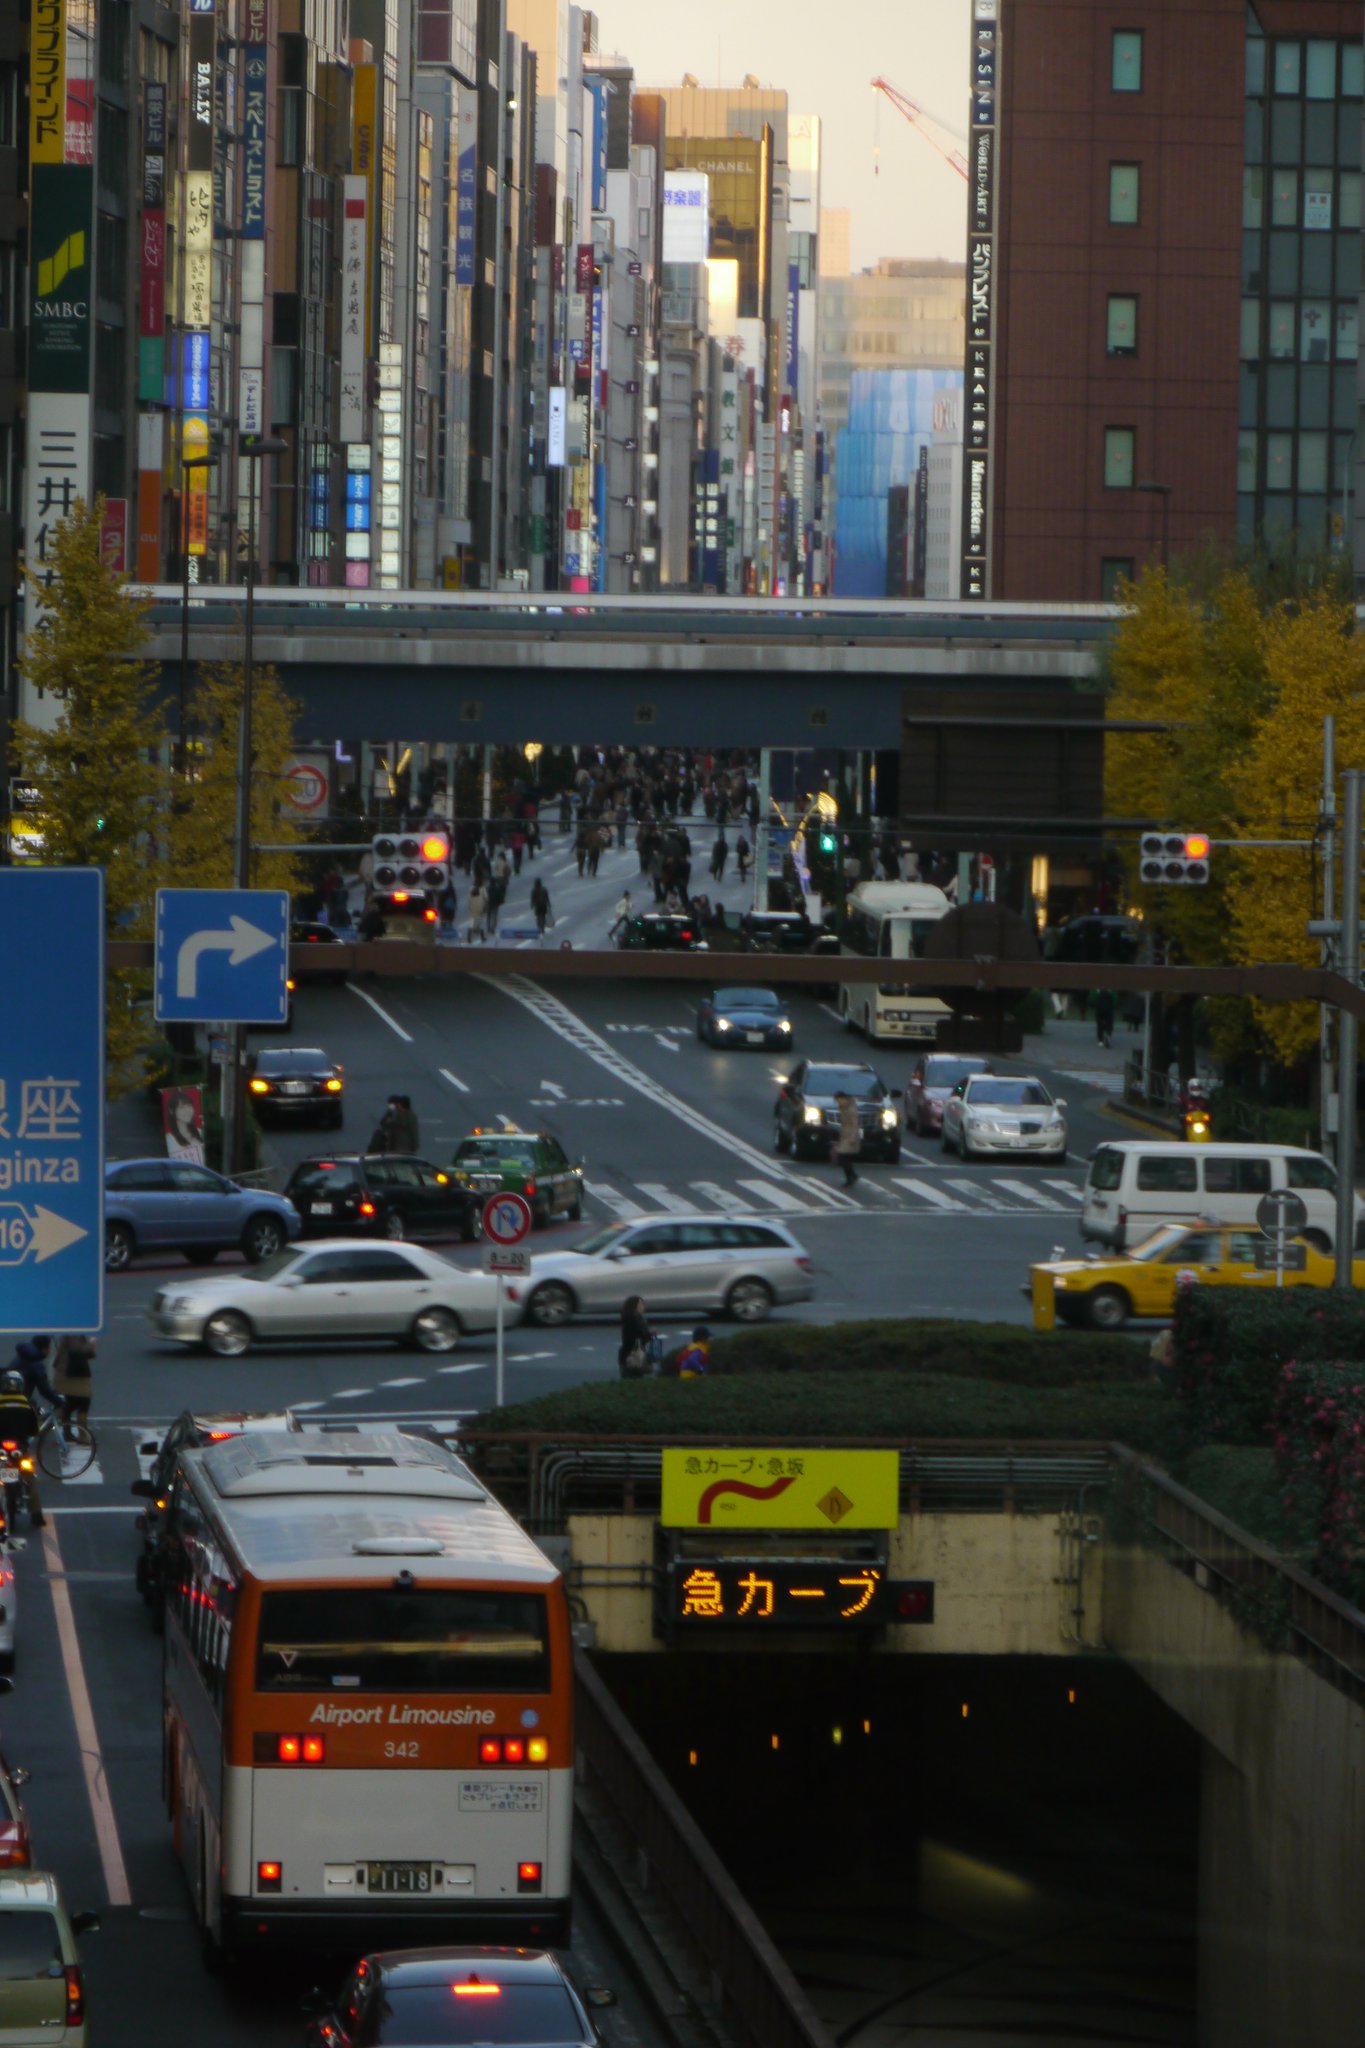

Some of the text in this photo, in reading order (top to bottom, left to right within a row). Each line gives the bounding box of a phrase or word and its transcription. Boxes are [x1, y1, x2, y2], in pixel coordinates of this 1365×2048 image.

[36, 0, 61, 144] ワブラインド
[196, 62, 212, 125] BALLY
[977, 30, 993, 104] RASIN
[246, 91, 265, 225] スペーストラスト
[698, 161, 754, 173] CHANEL
[457, 168, 474, 269] 名鉄観光
[34, 301, 87, 319] SMBC
[972, 243, 991, 322] バンプレスト
[0, 1075, 81, 1140] 座
[0, 1150, 80, 1190] ginza
[684, 1456, 805, 1476] 急カーブ・急坂
[682, 1569, 881, 1617] 急カーブ
[310, 1704, 496, 1727] Airport Limousine
[384, 1742, 419, 1758] 342
